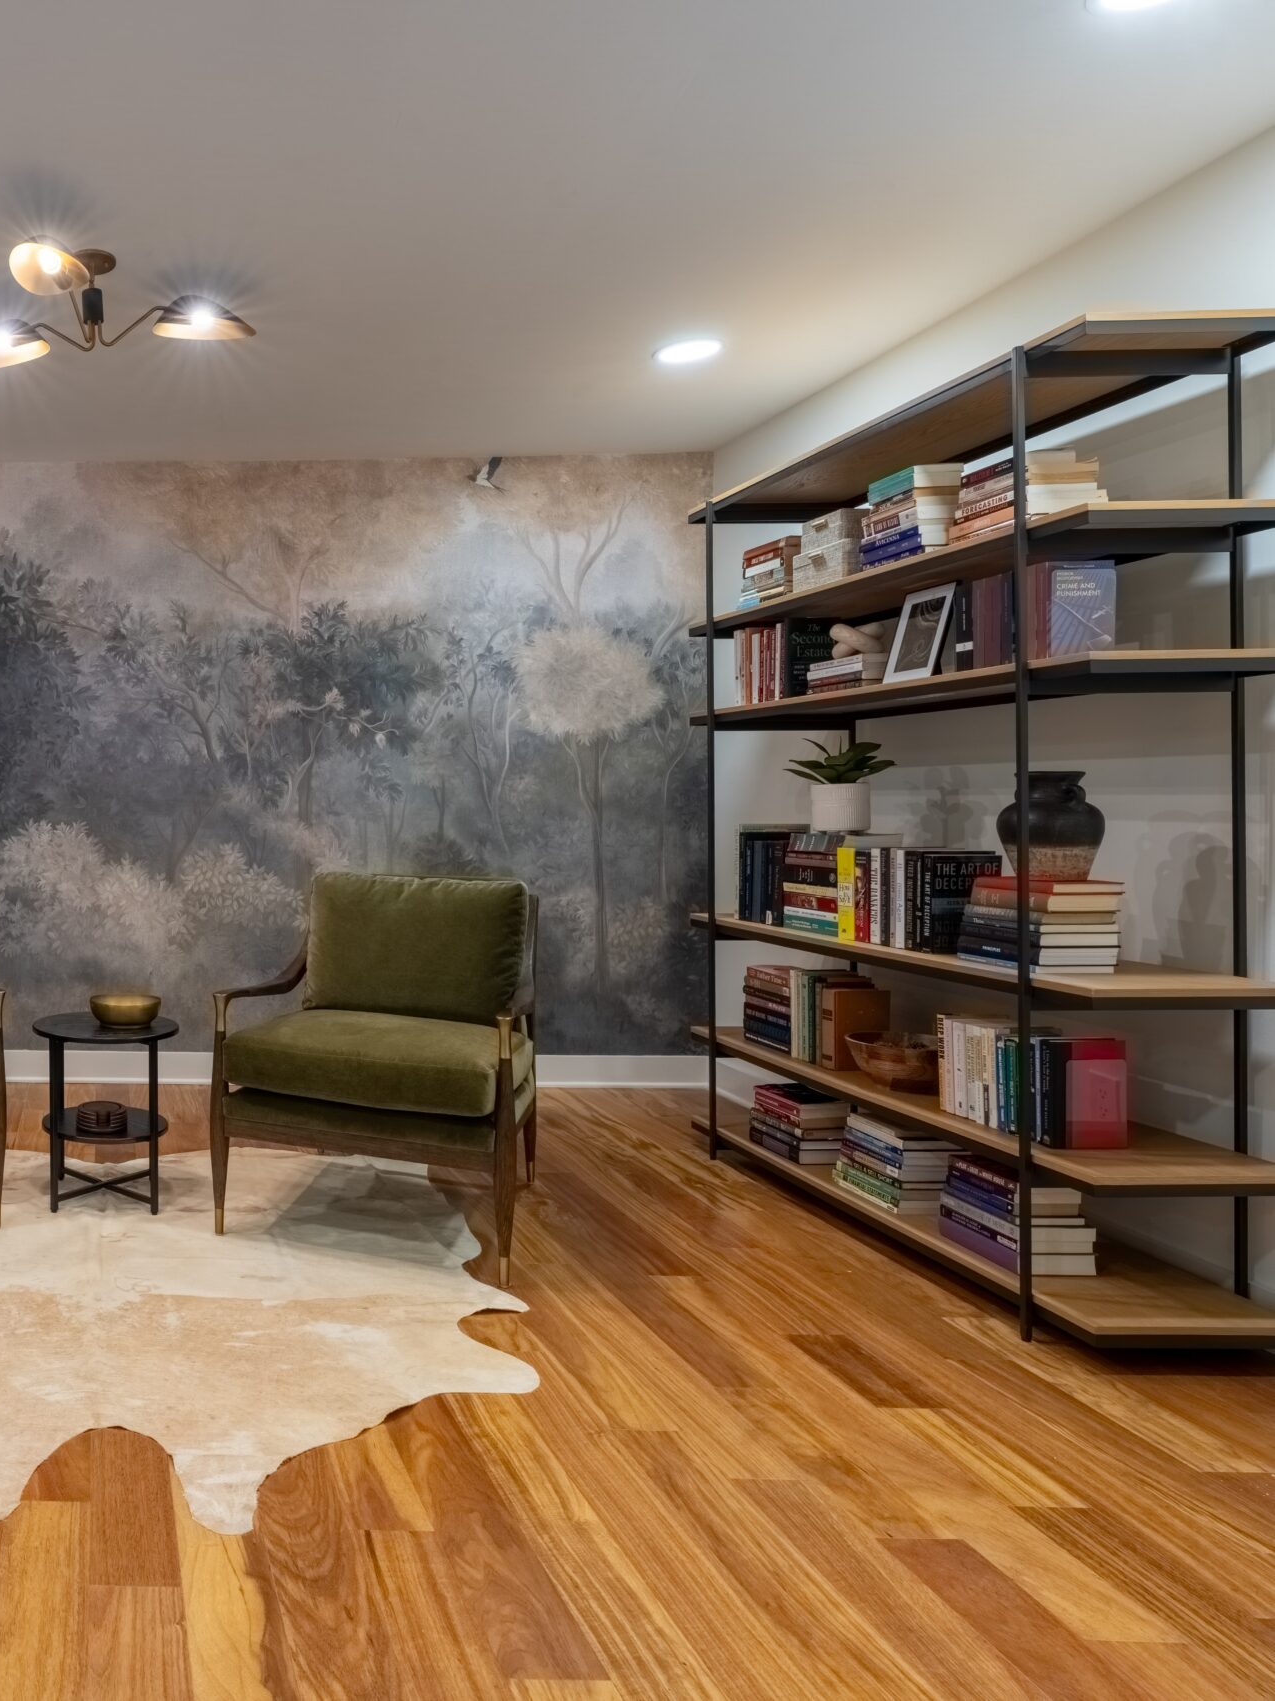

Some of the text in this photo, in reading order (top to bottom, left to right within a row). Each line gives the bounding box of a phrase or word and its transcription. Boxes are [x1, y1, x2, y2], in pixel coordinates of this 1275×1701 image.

[961, 494, 1008, 516] FORECASTING
[875, 533, 900, 547] AVICENNA
[1056, 582, 1078, 590] CRIME
[1056, 589, 1101, 597] PUNISHMENT
[807, 623, 821, 632] The
[796, 645, 832, 658] Estate
[935, 862, 999, 876] THE ART OF
[935, 876, 973, 891] DECEP
[870, 887, 878, 925] BANKERS
[923, 871, 931, 937] THE ART OF DECEPTION
[937, 1017, 945, 1060] DEEP WORK
